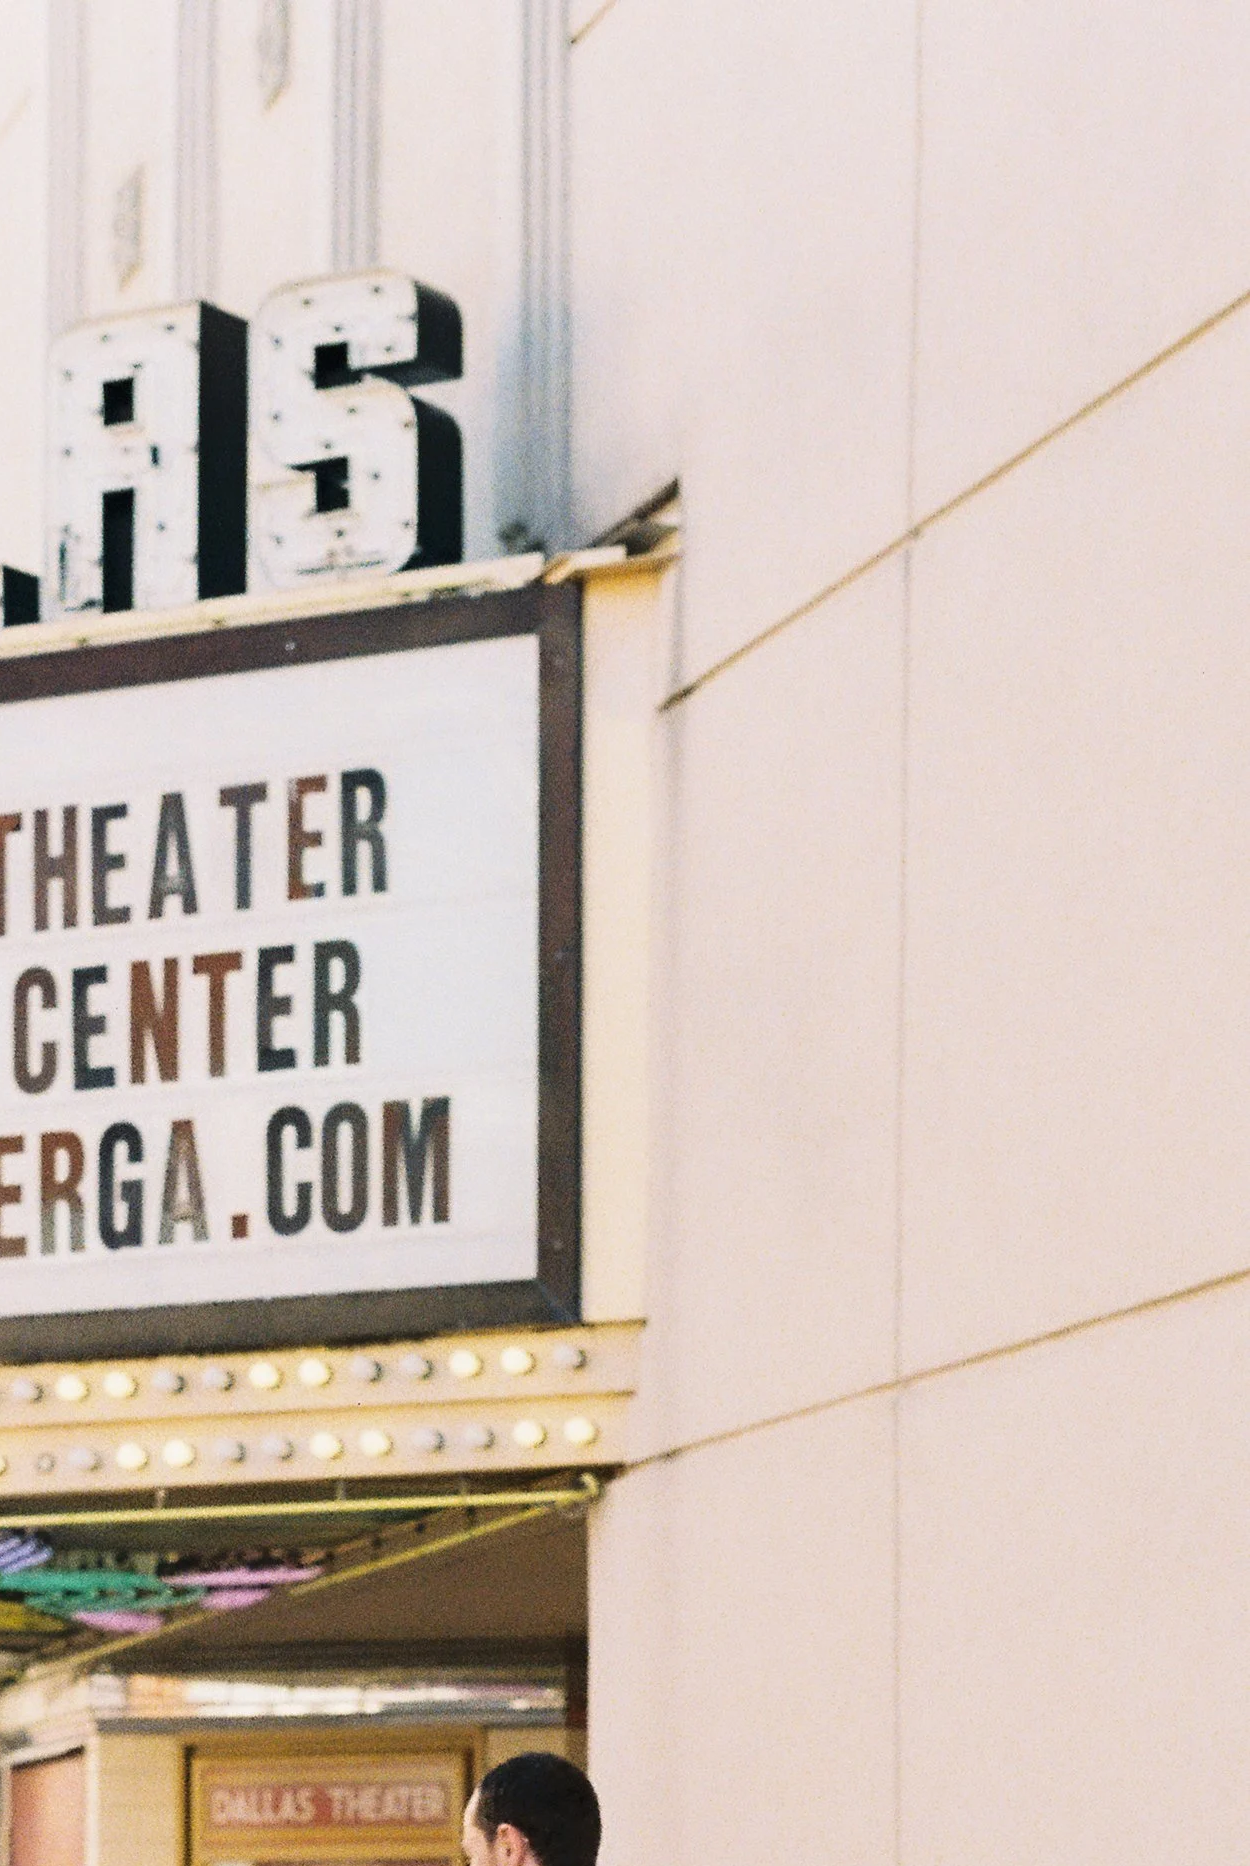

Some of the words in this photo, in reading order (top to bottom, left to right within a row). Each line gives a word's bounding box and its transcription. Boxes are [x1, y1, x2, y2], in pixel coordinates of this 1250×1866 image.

[12, 938, 362, 1096] CENTER
[210, 1785, 314, 1825] DALLAS
[329, 1784, 445, 1823] THEATER
